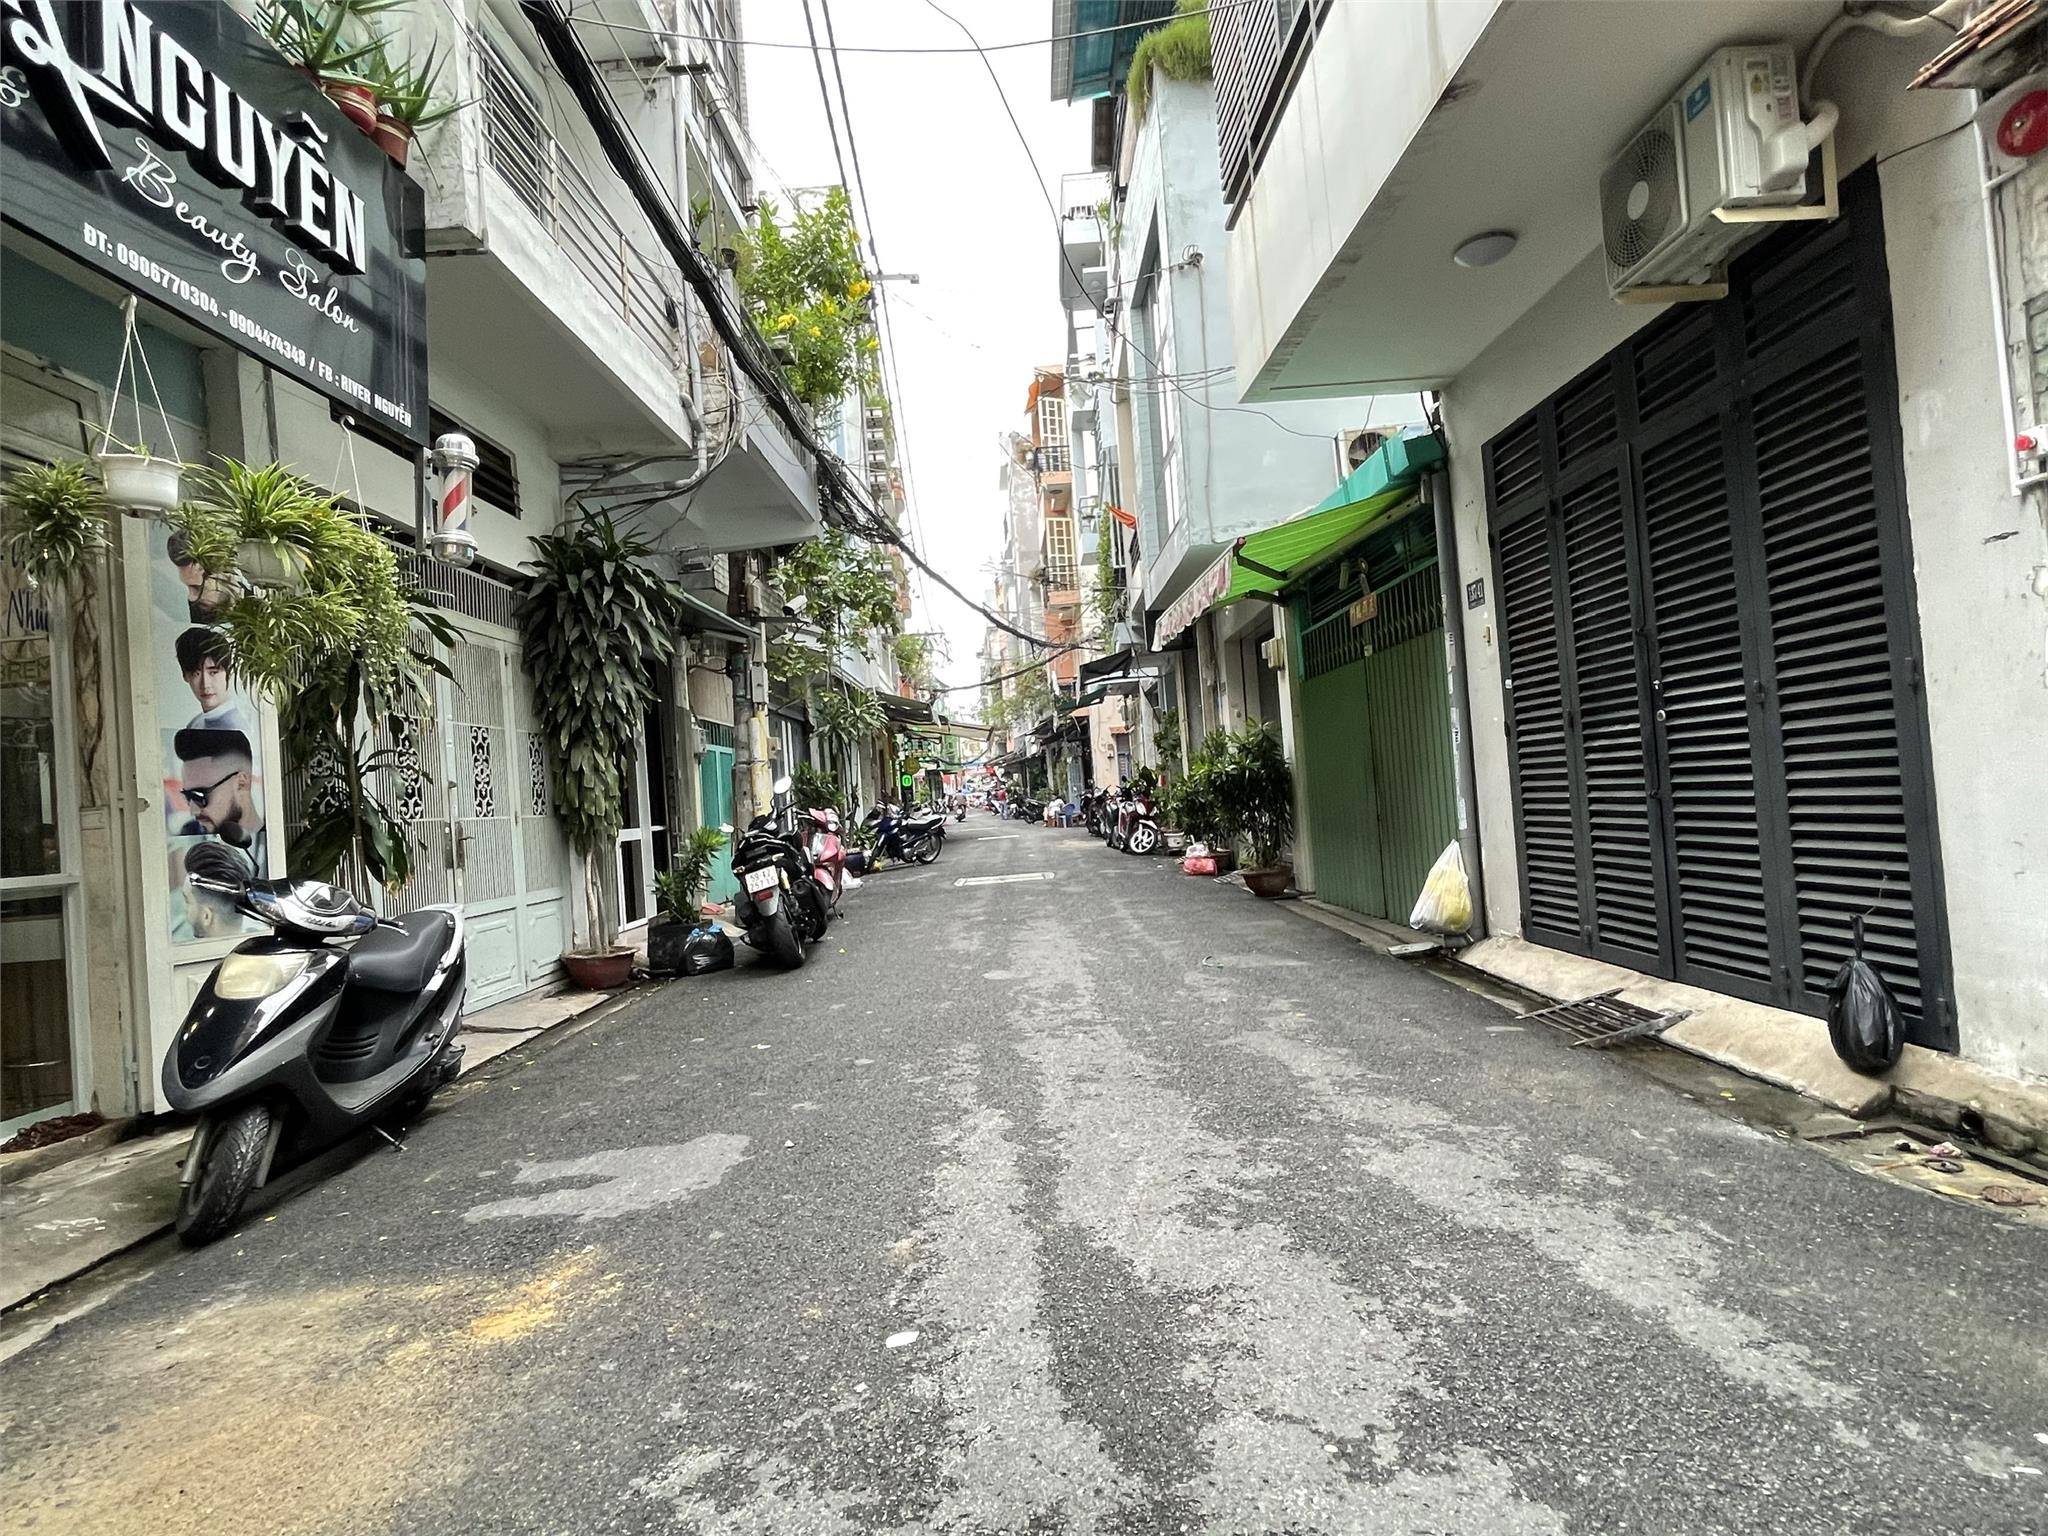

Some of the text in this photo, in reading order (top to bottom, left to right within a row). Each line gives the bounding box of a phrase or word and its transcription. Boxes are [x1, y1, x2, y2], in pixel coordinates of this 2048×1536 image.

[82, 221, 114, 258] ĐT:
[116, 242, 219, 317] 0906770304
[228, 308, 307, 368] 0904474348
[340, 374, 372, 406] RIVER
[121, 136, 261, 284] Beauty
[278, 247, 361, 334] Salon
